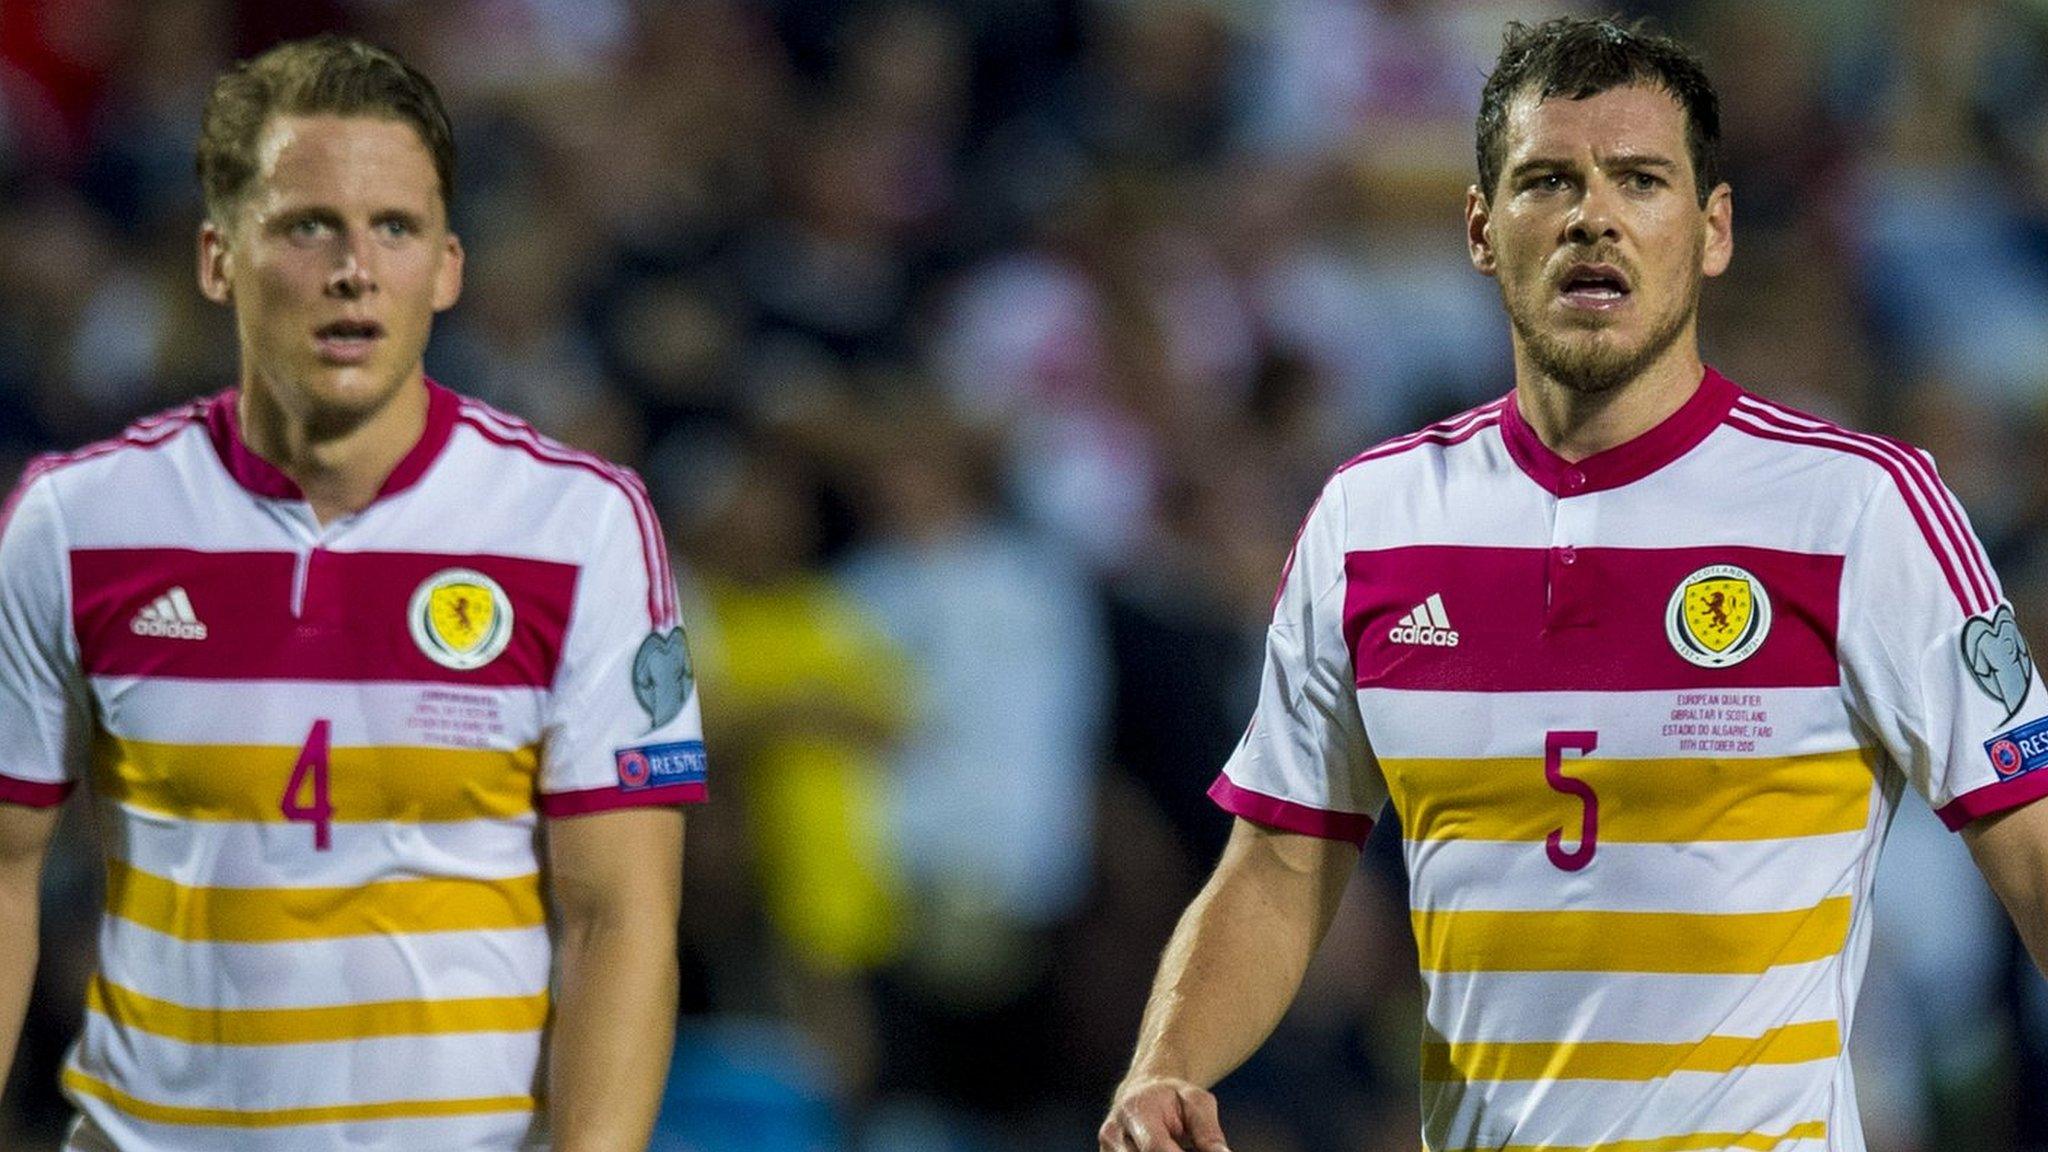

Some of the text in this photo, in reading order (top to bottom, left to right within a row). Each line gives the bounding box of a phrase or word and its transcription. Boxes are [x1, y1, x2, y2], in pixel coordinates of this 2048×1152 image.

[1692, 567, 1743, 581] SCOTLAND
[130, 618, 207, 640] adidas
[1389, 624, 1459, 647] adidas
[1677, 694, 1761, 706] EUROPEAN QUALIFIER
[1670, 709, 1716, 721] GIBRALTAR
[1726, 710, 1767, 723] SCOTLAND
[1662, 725, 1696, 736] ESTADIO
[1698, 725, 1709, 735] DO
[1752, 726, 1773, 738] FARO
[1699, 740, 1735, 752] OCTOBER
[1737, 741, 1755, 753] 2015
[281, 719, 334, 852] 4
[1545, 731, 1598, 872] 5
